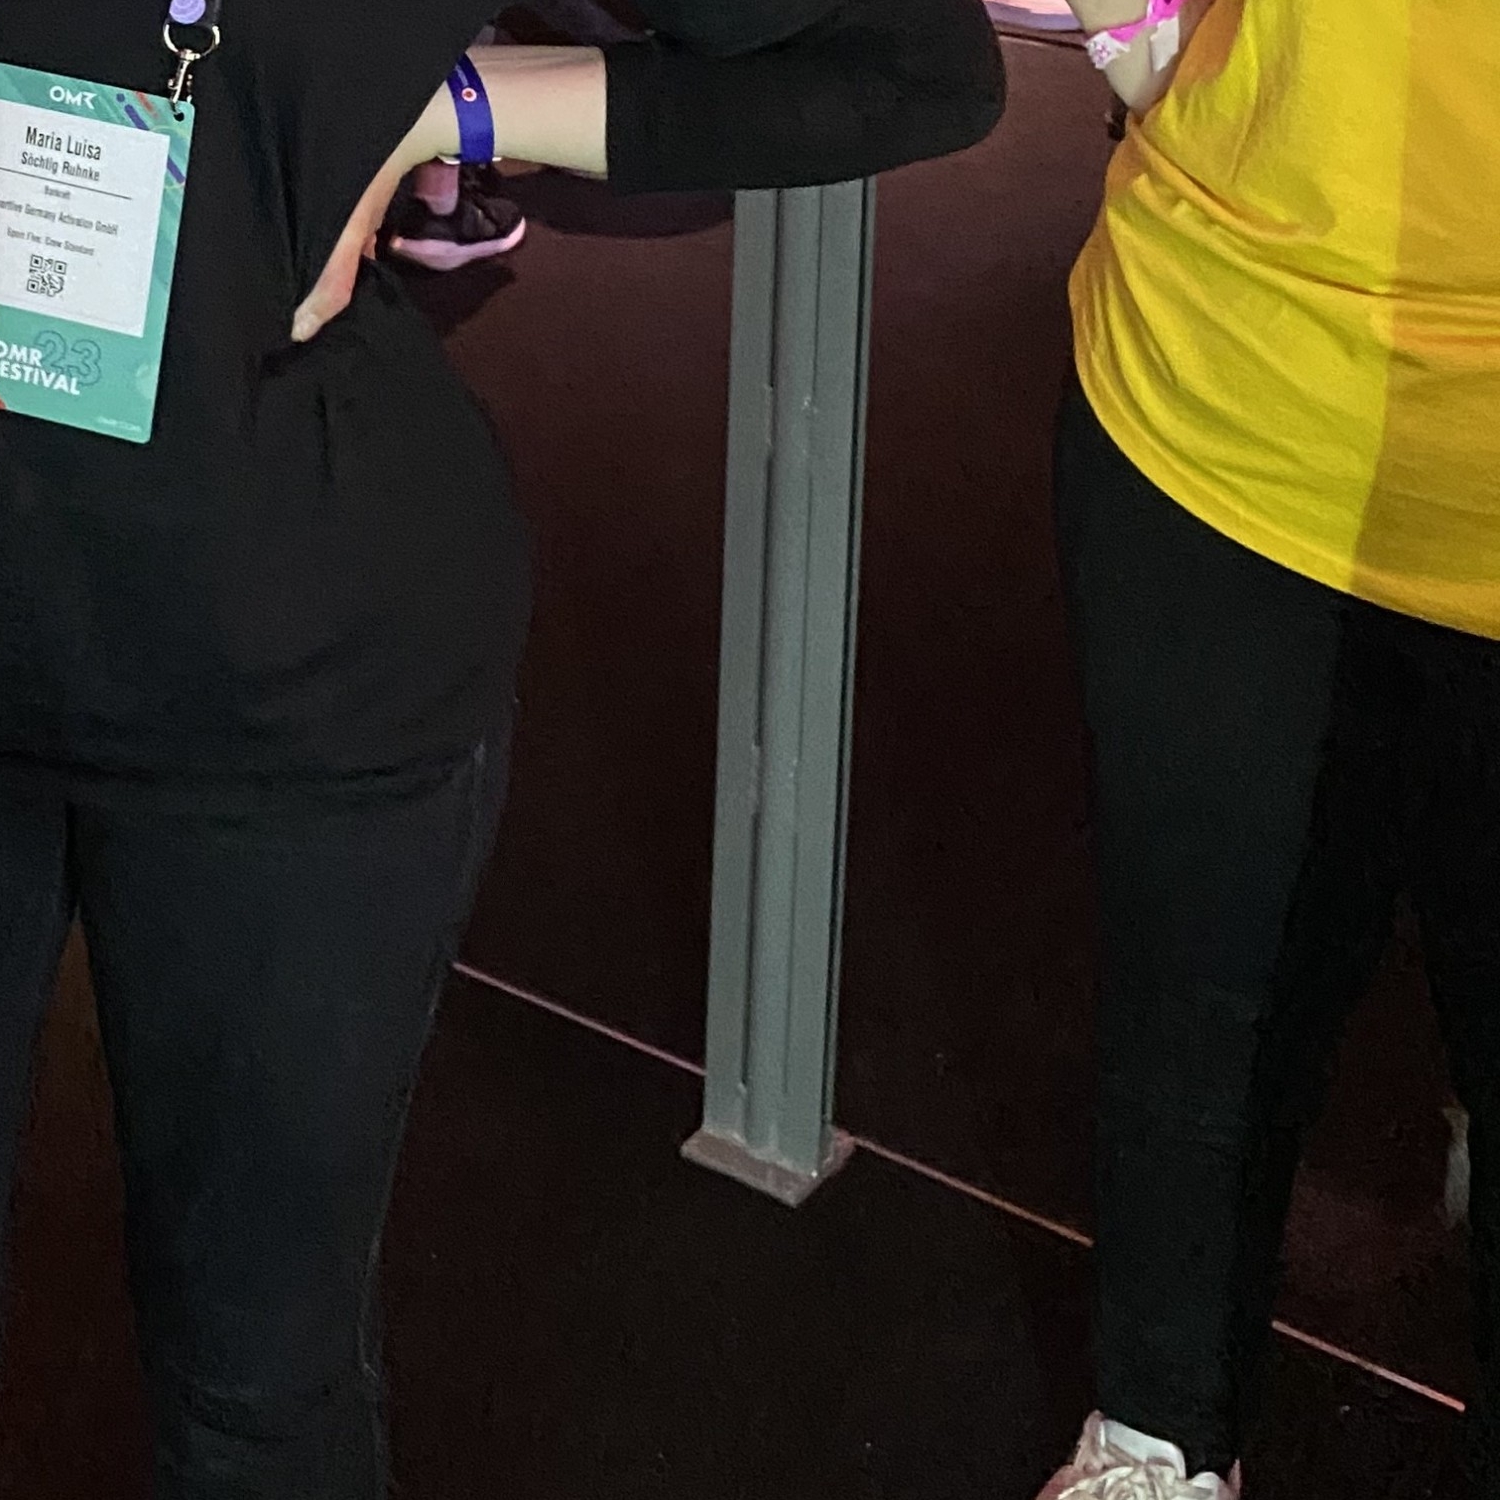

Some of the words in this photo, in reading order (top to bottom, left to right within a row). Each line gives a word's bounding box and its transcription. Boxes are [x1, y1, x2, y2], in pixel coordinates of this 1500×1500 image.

[49, 85, 98, 110] OMR
[26, 126, 62, 152] Maria
[67, 135, 101, 160] Luisa
[62, 161, 100, 181] Ruhnke
